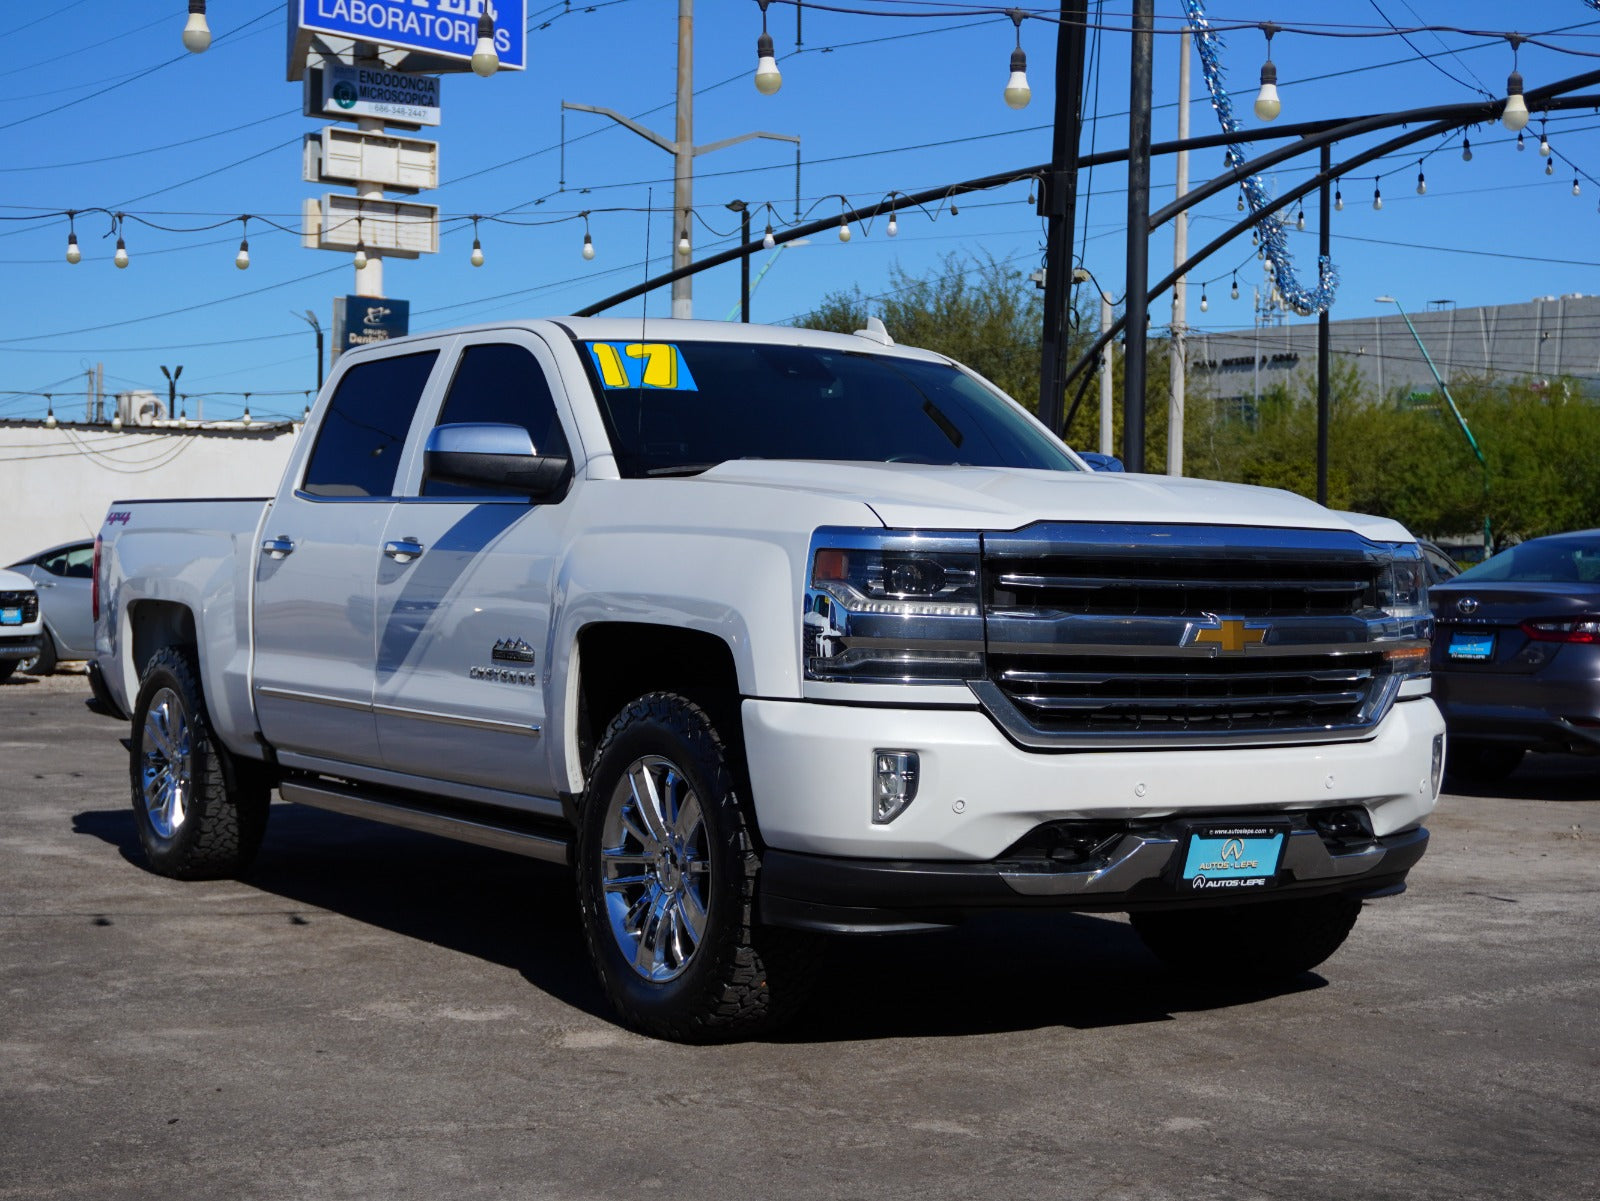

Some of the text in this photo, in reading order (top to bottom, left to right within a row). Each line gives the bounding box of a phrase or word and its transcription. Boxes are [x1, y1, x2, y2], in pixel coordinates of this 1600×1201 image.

[317, 0, 511, 52] LABORATORIS
[359, 70, 435, 93] ENDODONCIA
[359, 86, 435, 107] MICROSCOPICA
[592, 343, 678, 389] 17
